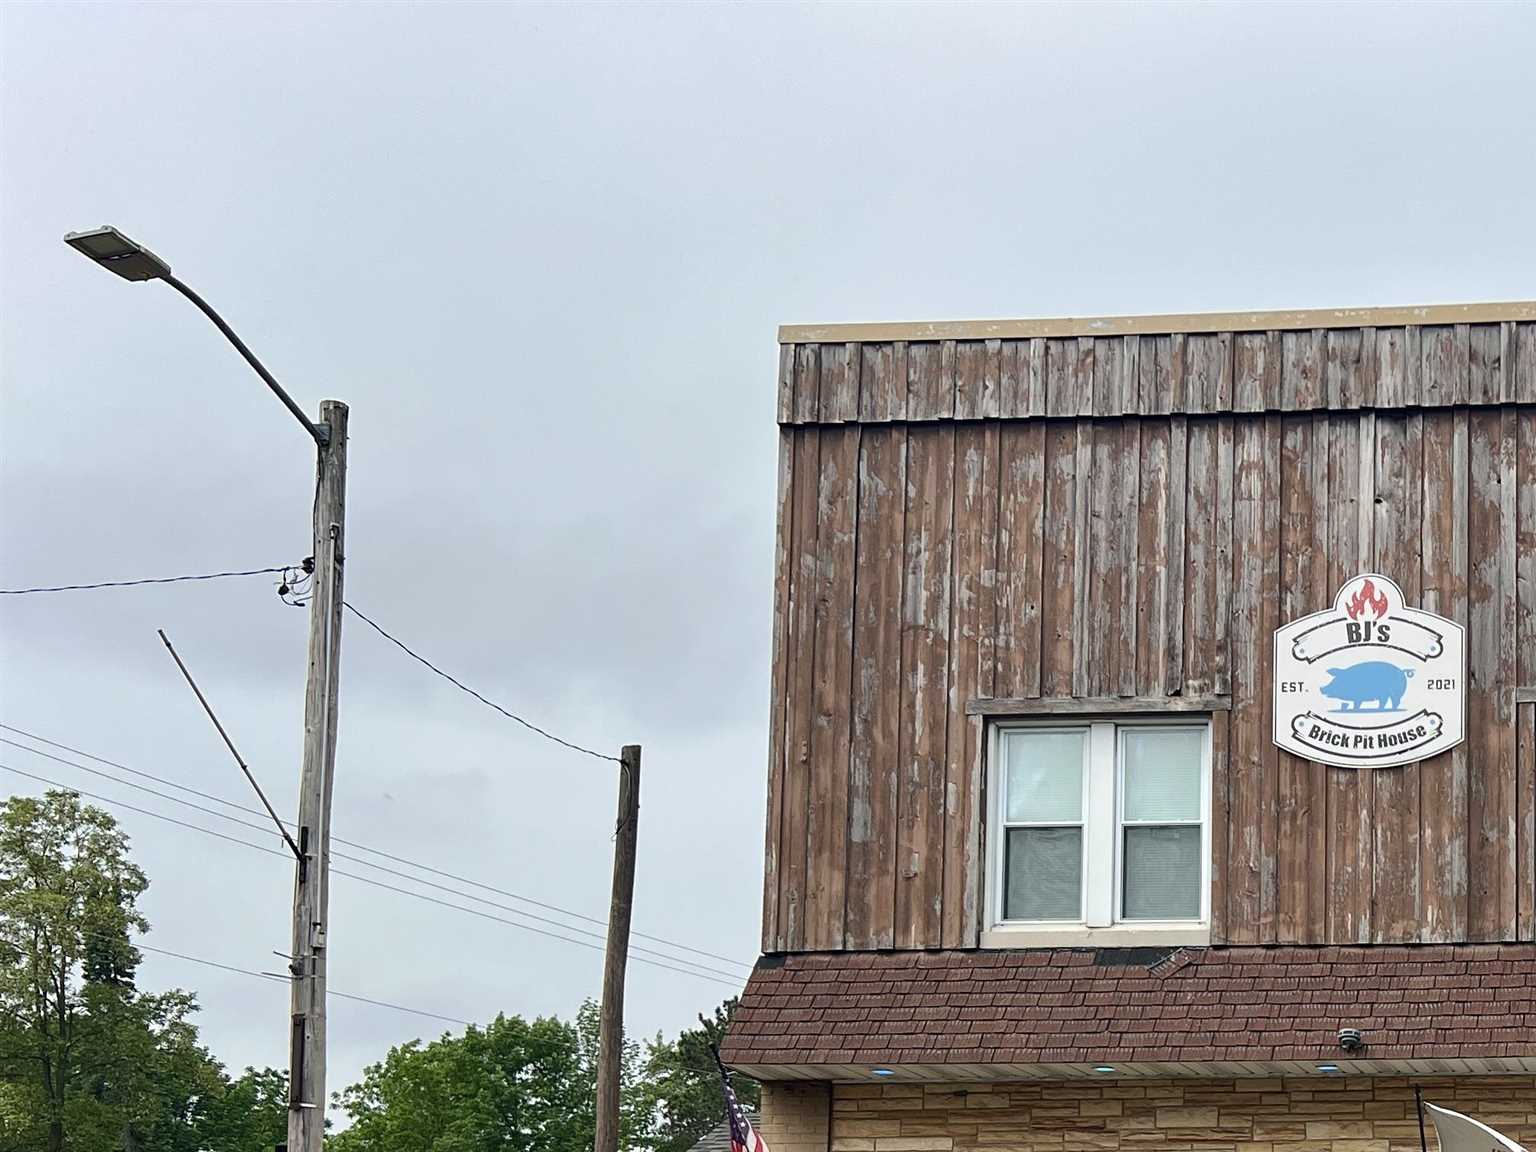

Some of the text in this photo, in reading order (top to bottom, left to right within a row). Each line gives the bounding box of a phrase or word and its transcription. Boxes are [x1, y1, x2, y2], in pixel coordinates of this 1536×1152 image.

[1346, 621, 1391, 644] BJ's
[1281, 679, 1456, 693] EST. 2021
[1308, 725, 1427, 750] Brick Pit House
